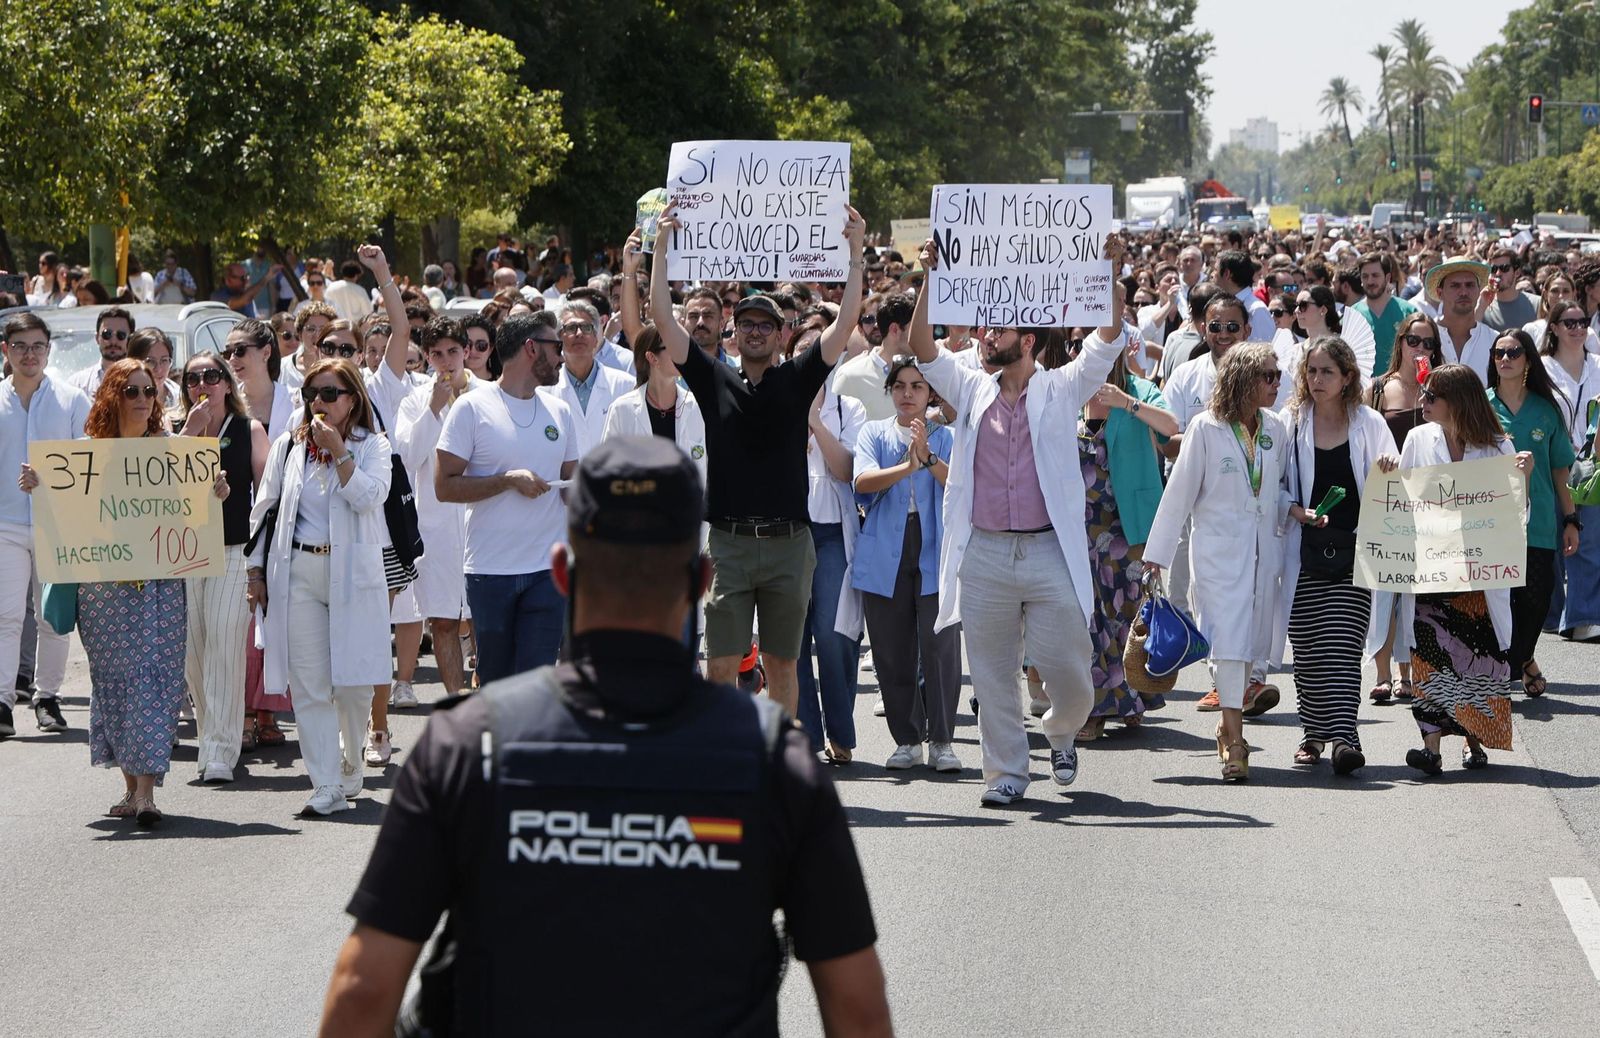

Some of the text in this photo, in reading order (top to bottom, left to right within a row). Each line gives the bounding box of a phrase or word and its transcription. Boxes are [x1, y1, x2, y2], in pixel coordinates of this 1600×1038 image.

[736, 151, 769, 188] NO
[721, 189, 754, 219] NO
[1001, 192, 1093, 230] MÉDICOS
[810, 224, 839, 251] EL
[931, 228, 1100, 271] NO HAY SALUD, SIN
[681, 254, 779, 279] TRABAJO!
[938, 272, 1069, 306] DERECHOS NO HAY
[45, 448, 219, 495] 37 HORAS?
[99, 495, 192, 522] NOSOTROS
[1386, 479, 1495, 513] FALTAN MEDICOS
[56, 524, 199, 565] HACEMOS 100
[1366, 542, 1484, 562] FALTAN CONDICIONES
[1378, 561, 1520, 584] LABORALES JUSTAS
[509, 809, 696, 842] POLICIA
[507, 837, 742, 871] NACIONAL
